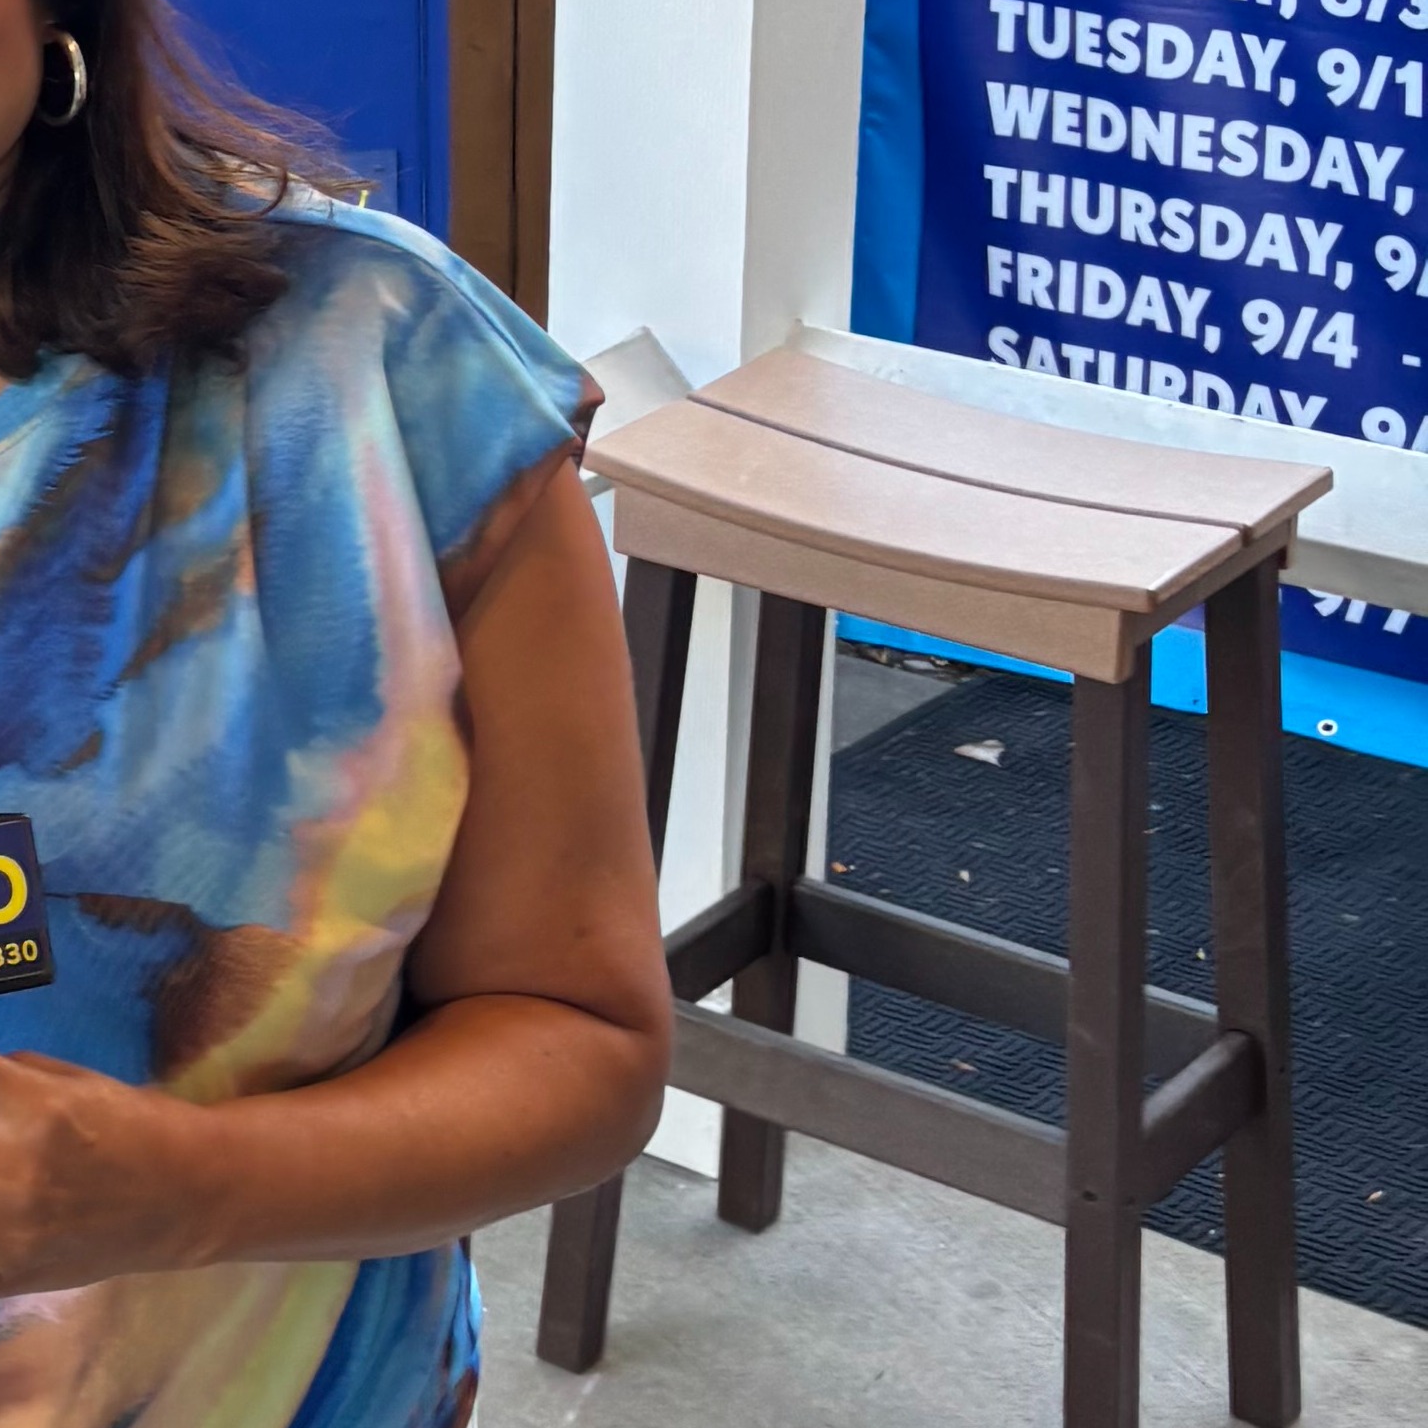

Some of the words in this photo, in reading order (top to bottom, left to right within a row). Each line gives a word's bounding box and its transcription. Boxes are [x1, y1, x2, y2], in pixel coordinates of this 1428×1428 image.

[1317, 47, 1423, 119] 9/1
[985, 81, 1415, 217] WEDNESDAY,
[983, 165, 1354, 291] THURSDAY,
[986, 245, 1222, 354] FRIDAY,
[1241, 298, 1359, 369] 9/4
